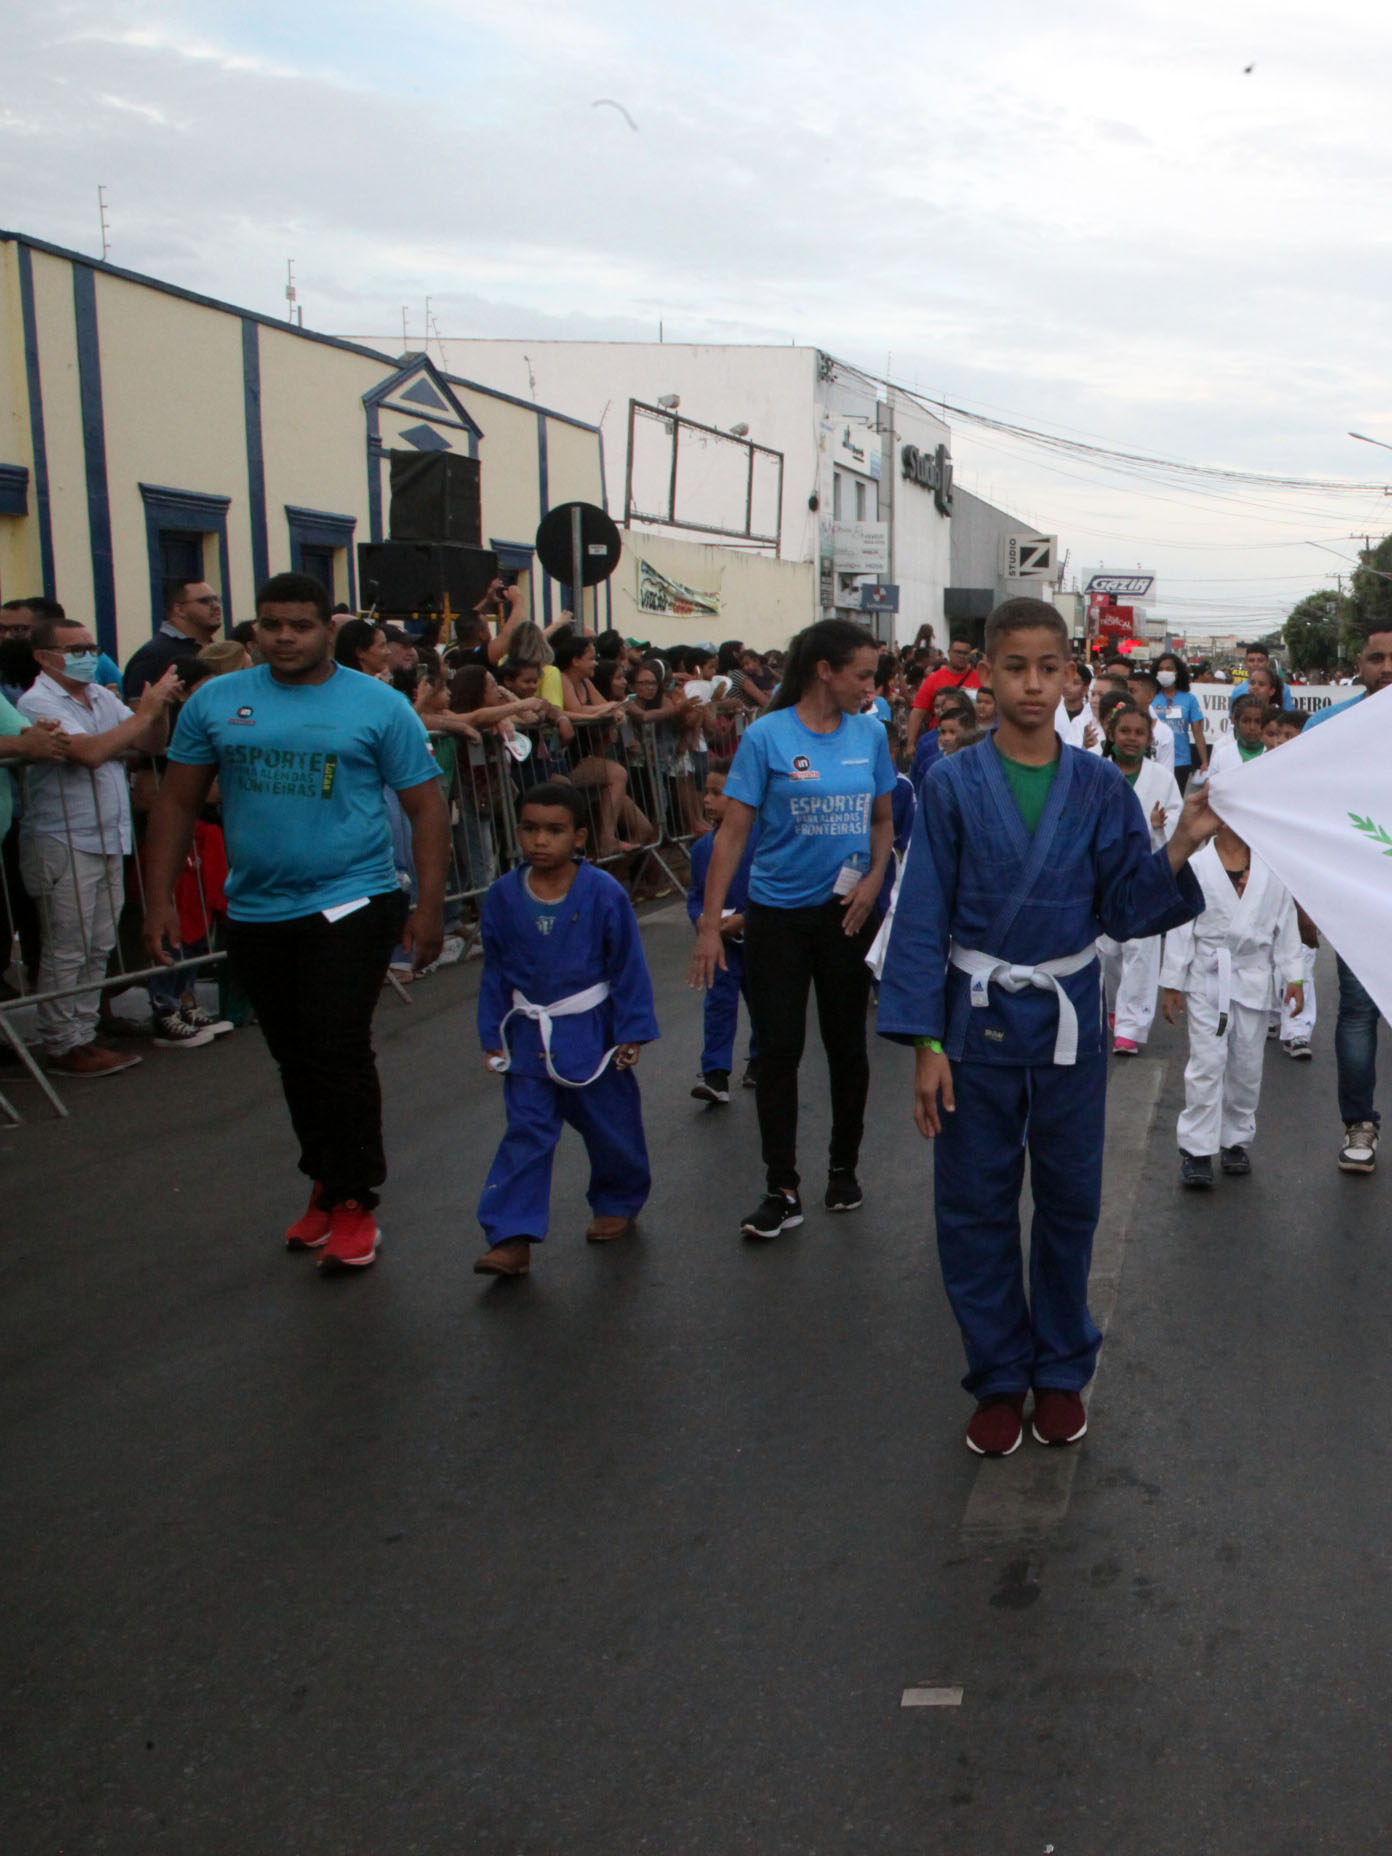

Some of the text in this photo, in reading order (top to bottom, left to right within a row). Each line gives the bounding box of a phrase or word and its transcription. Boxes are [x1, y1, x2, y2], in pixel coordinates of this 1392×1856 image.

[1008, 537, 1017, 577] STUDIO
[224, 744, 323, 772] ESPORTE
[790, 793, 865, 815] ESPORTE
[794, 822, 862, 836] FRONTEIRAS
